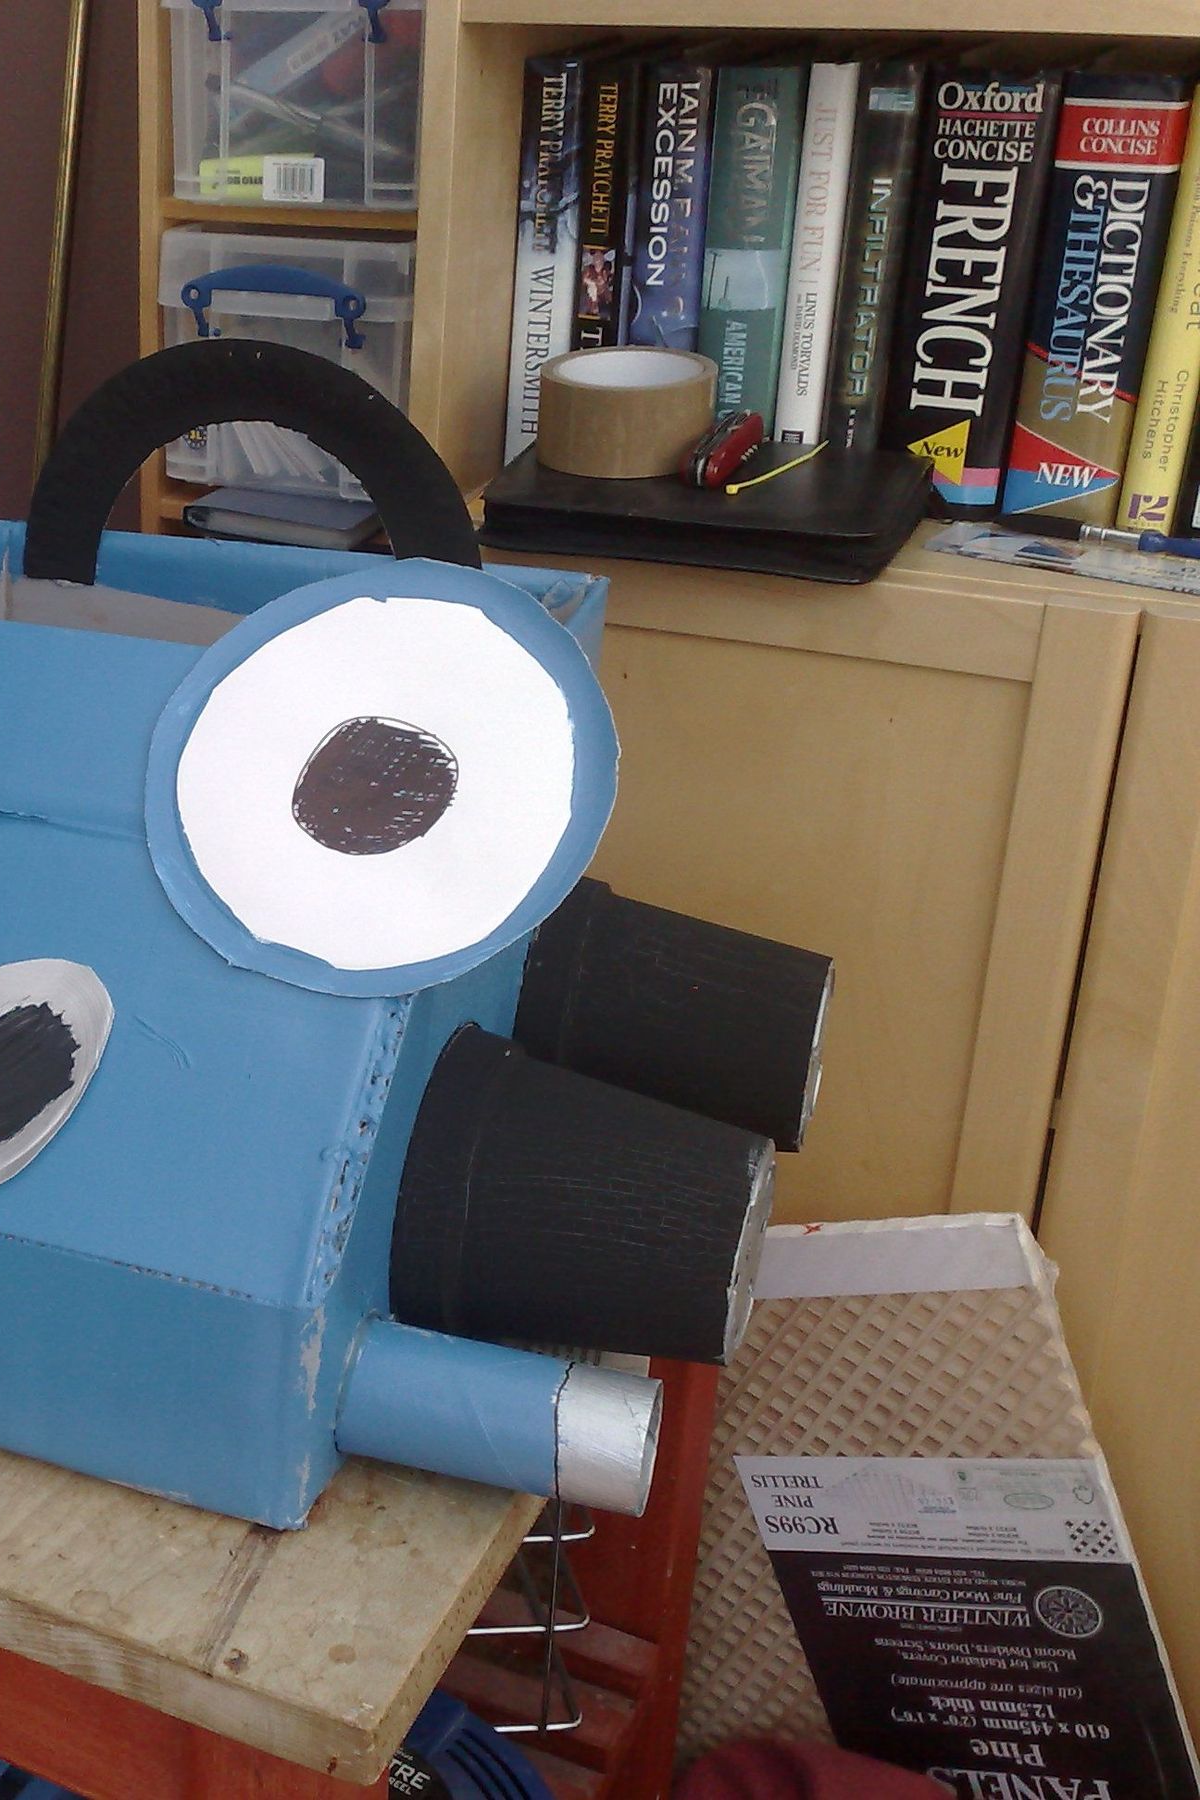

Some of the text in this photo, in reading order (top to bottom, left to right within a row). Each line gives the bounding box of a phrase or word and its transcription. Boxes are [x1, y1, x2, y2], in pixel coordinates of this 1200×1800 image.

[541, 72, 567, 134] TERRY
[938, 81, 1044, 113] Oxford
[678, 81, 700, 153] IAIN
[937, 118, 1036, 138] HACHETTE
[1082, 118, 1160, 137] COLLINS
[933, 138, 1034, 162] CONCISE
[1079, 136, 1158, 155] CONCISE
[590, 82, 618, 235] TERRY PRATCHETT
[646, 83, 679, 287] EXCESSION
[799, 104, 837, 274] JUST FOR FUN
[849, 178, 893, 396] INFILTRATOR
[908, 163, 1019, 417] FRENCH
[1077, 177, 1151, 424] DICTIONARY
[1039, 204, 1105, 422] THESAURUS
[520, 265, 555, 435] WINTERSMITH
[796, 292, 817, 397] LINUS TORVALDS
[718, 320, 747, 414] AMERICAN
[1142, 380, 1169, 460] Hitchens
[1158, 370, 1190, 472] Christopher
[919, 439, 965, 459] New
[1034, 462, 1100, 489] NEW
[751, 1474, 824, 1489] TRELLIS
[771, 1495, 814, 1508] PINE
[764, 1515, 840, 1535] RC99S
[817, 1582, 878, 1596] Mouldings
[896, 1587, 950, 1600] Carvings
[953, 1590, 989, 1601] Wood
[991, 1591, 1022, 1603] Fine
[824, 1601, 1031, 1628] WINTHER BROWNE
[875, 1637, 924, 1651] Screens
[929, 1640, 969, 1654] Doors,
[1035, 1649, 1077, 1660] Room
[951, 1655, 1008, 1670] Radiator
[1010, 1659, 1030, 1670] for
[1034, 1661, 1059, 1673] Use
[891, 1673, 1083, 1700] (all sizes are approximate)
[928, 1712, 939, 1722] x
[929, 1696, 1056, 1719] 12.5mm thick
[983, 1717, 1052, 1737] 445mm
[1058, 1722, 1072, 1734] x
[1075, 1723, 1110, 1739] 610
[969, 1738, 1047, 1768] Pine
[388, 1757, 432, 1790] TRE
